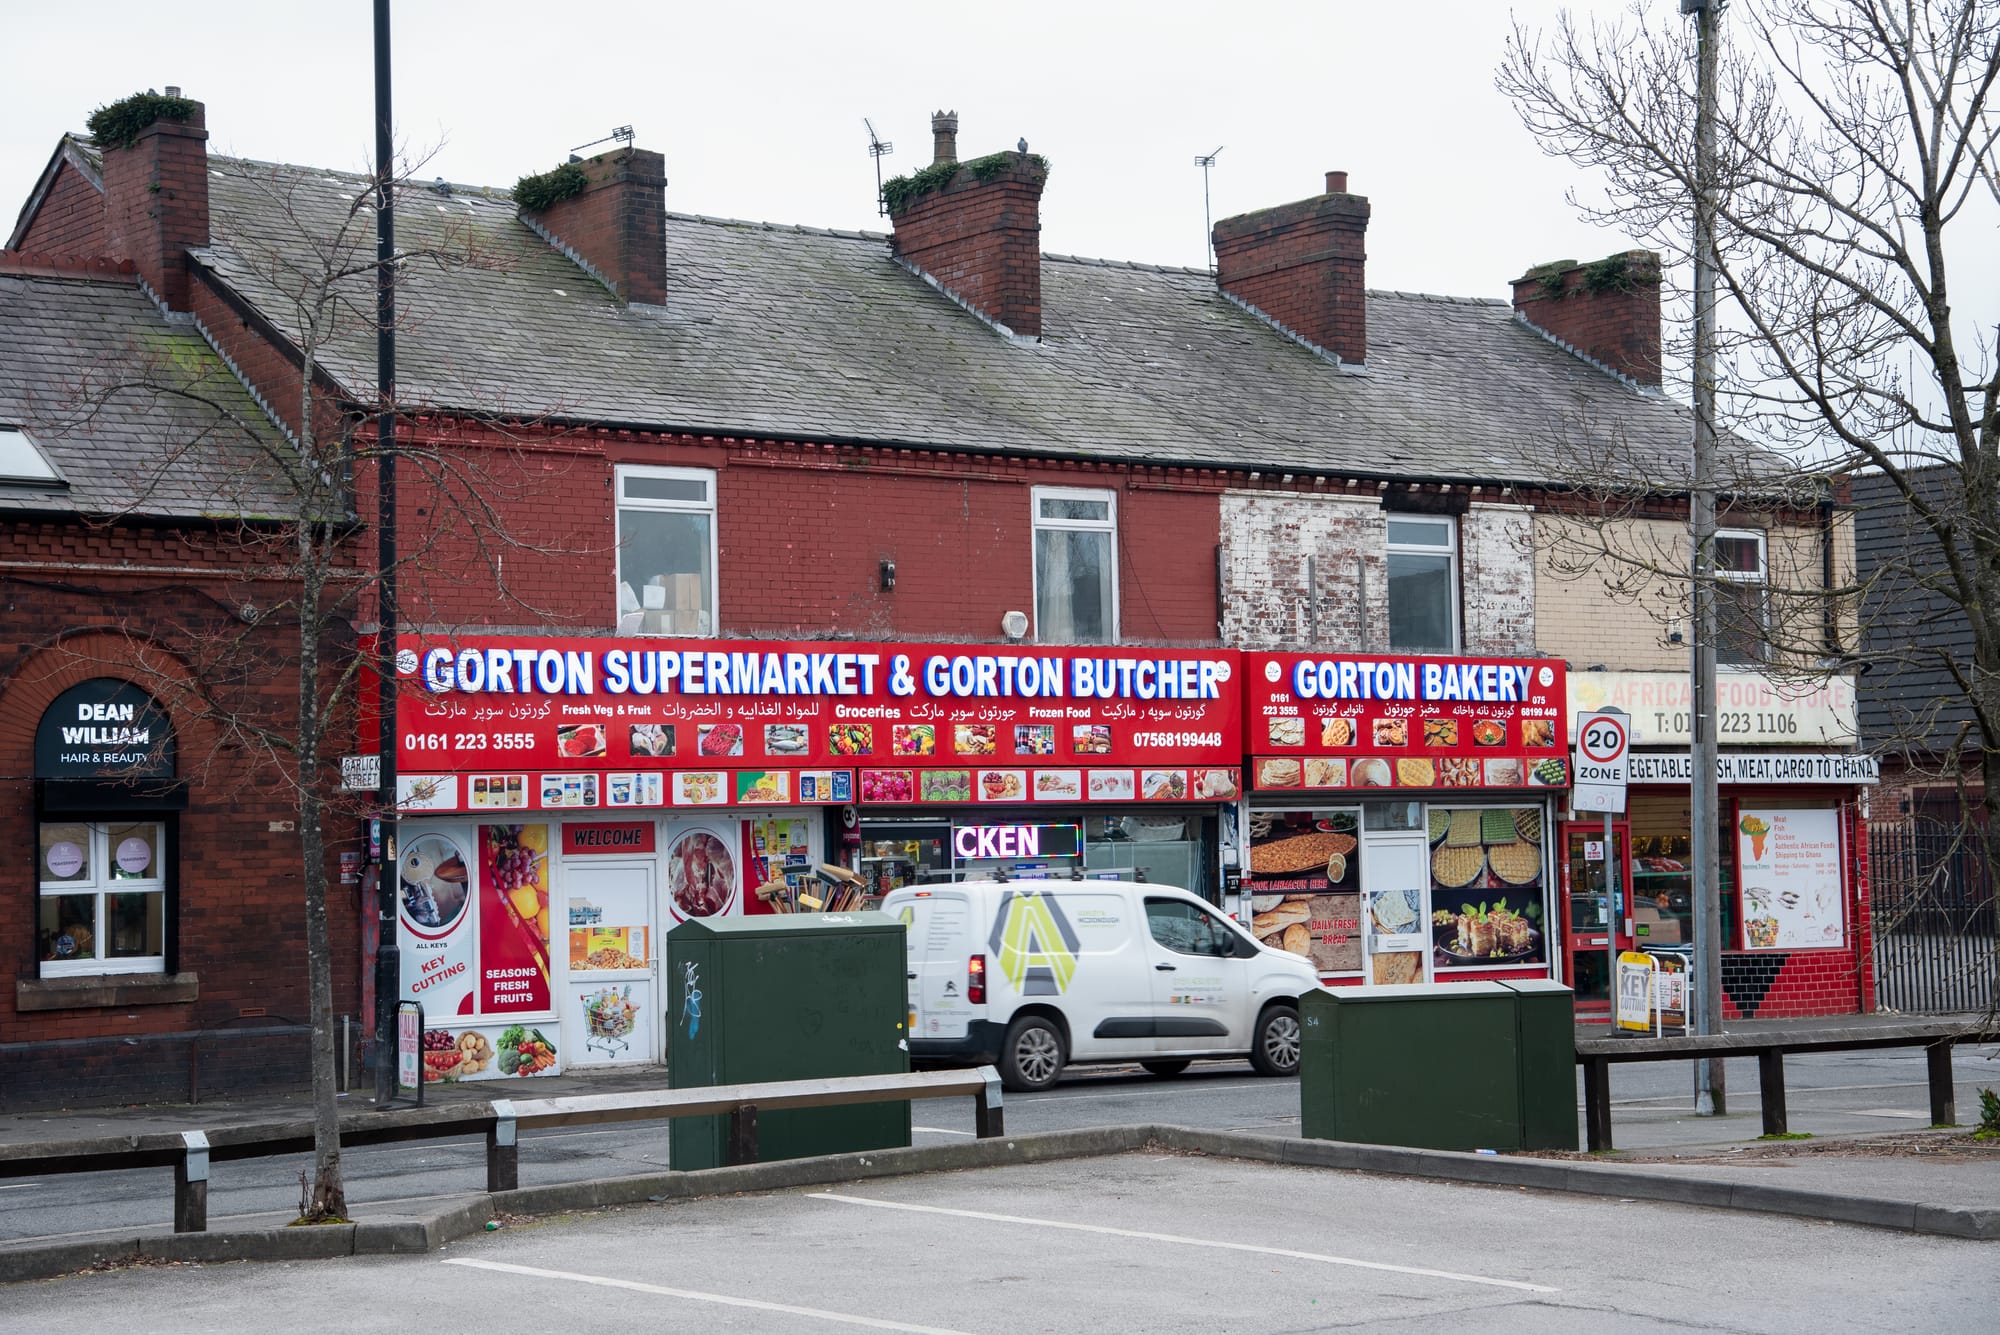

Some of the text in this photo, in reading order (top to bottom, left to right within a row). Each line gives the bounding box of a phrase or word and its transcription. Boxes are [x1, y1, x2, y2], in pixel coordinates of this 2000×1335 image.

[423, 648, 594, 695] GORTON
[603, 649, 879, 696] SUPERMARKET
[889, 654, 916, 697] &
[925, 655, 1064, 698] GORTON
[1071, 657, 1220, 701] BUTCHER
[1293, 659, 1416, 700] GORTON
[1421, 663, 1534, 702] BAKERY
[1270, 694, 1290, 703] 0161
[1532, 696, 1546, 705] 075
[1611, 682, 1847, 708] AFRICA FOOD STORE
[78, 703, 134, 721] DEAN
[562, 704, 652, 719] Fresh Veg & Fruit
[663, 702, 721, 720] الخضروات
[786, 702, 819, 720] للمواد
[835, 705, 901, 719] Groceries
[978, 705, 1016, 721] جورتون
[1030, 706, 1091, 719] Frozen Food
[1263, 706, 1299, 715] 223 3555
[1521, 707, 1558, 717] 68199 448
[1654, 712, 1798, 734] T: 01 223 1106
[62, 727, 149, 744] WILLIAM
[405, 733, 535, 750] 0161 223 3555
[1133, 732, 1222, 748] 07568199448
[1587, 729, 1618, 749] 20
[61, 753, 147, 763] HAIR & BEAUTY
[344, 758, 381, 772] GARLICK
[1580, 767, 1621, 780] ZONE
[1738, 759, 1773, 782] MEAT,
[1775, 759, 1813, 778] CARGO
[1816, 759, 1831, 778] TO
[1835, 759, 1874, 778] GHANA
[347, 773, 378, 786] STREET
[574, 830, 643, 847] WELCOME
[954, 826, 1039, 858] CKEN
[1309, 879, 1329, 889] HERE
[1311, 919, 1358, 931] DAILY FRESH
[430, 941, 448, 949] KEYS
[1322, 934, 1348, 945] BREAD
[420, 954, 446, 975] KEY
[411, 961, 467, 994] CUTTING
[486, 967, 537, 979] SEASONS
[494, 980, 530, 991] FRESH
[1620, 974, 1650, 998] KEY
[493, 992, 534, 1005] FRUITS
[1620, 997, 1646, 1012] CUTTING
[1307, 1016, 1320, 1027] S4
